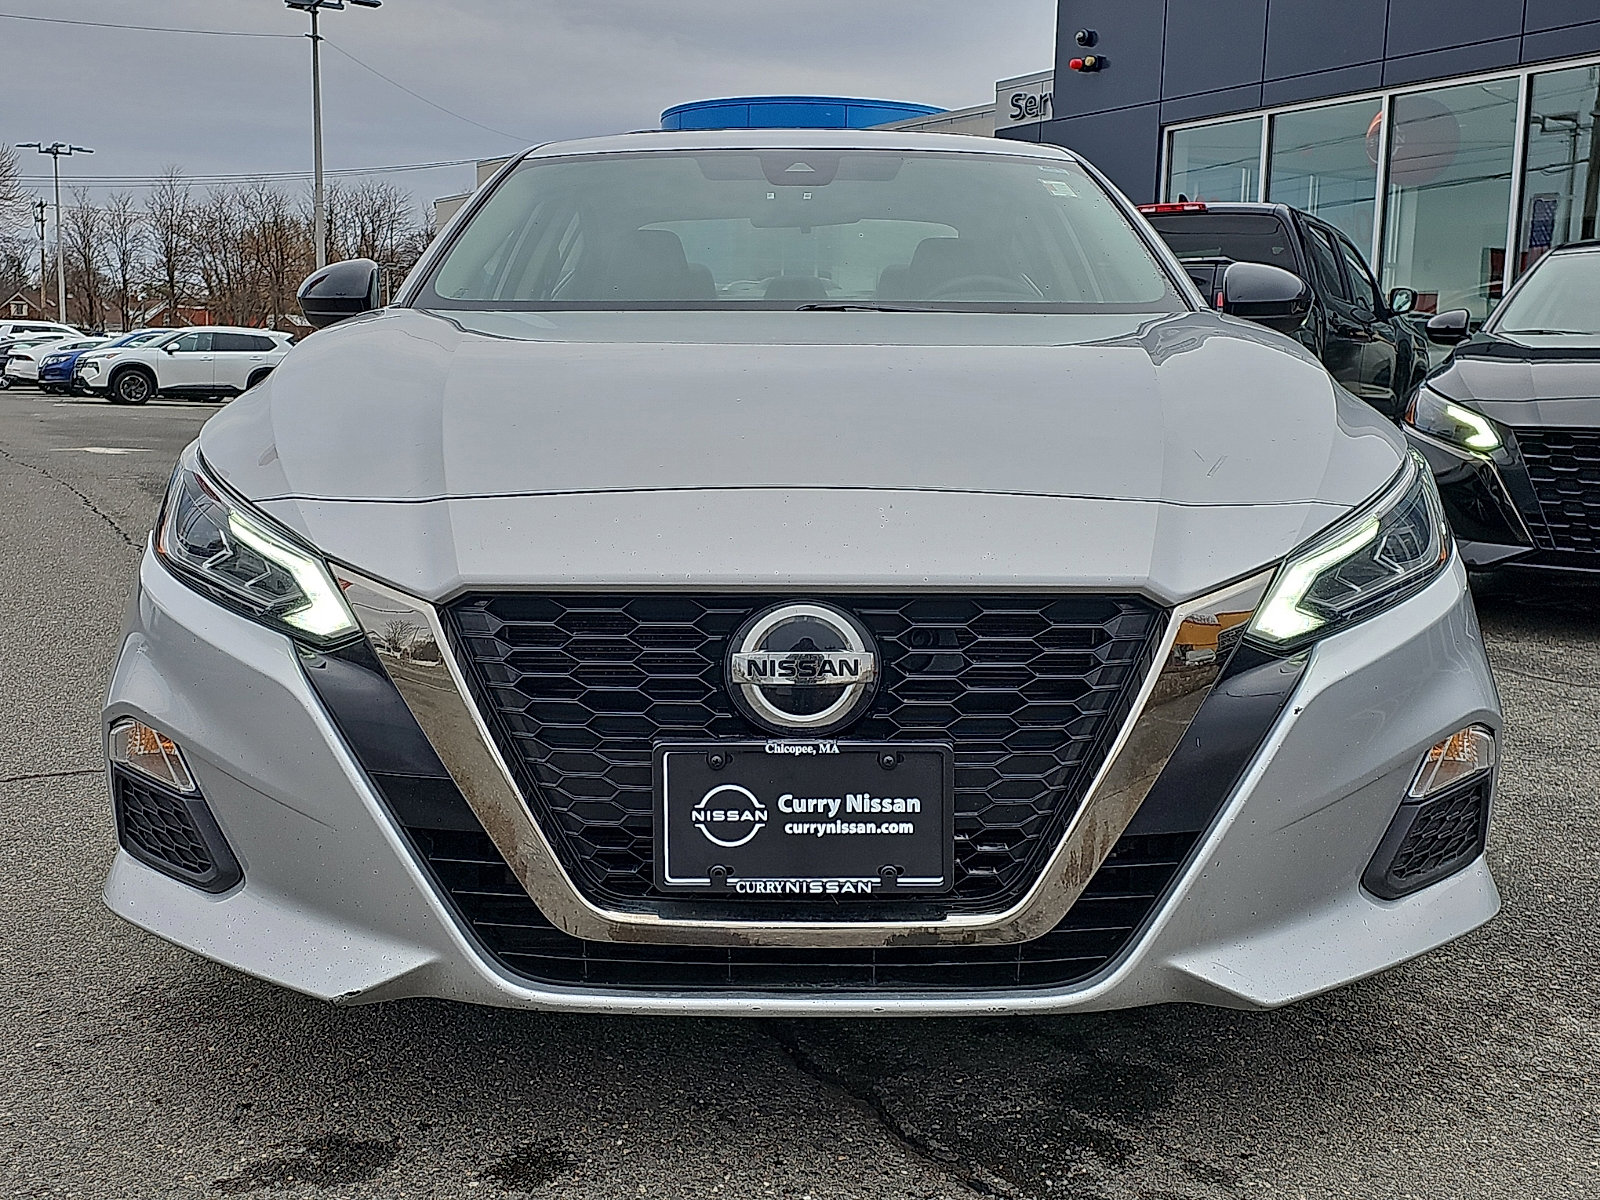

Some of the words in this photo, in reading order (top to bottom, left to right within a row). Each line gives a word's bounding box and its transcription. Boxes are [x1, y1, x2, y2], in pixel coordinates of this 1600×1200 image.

[747, 659, 859, 677] NISSAN
[765, 743, 817, 756] Chicopee,
[818, 743, 840, 754] MA
[777, 793, 841, 818] Curry
[845, 793, 921, 814] Nissan
[691, 809, 768, 822] NISSAN
[784, 819, 914, 837] currynissan.com
